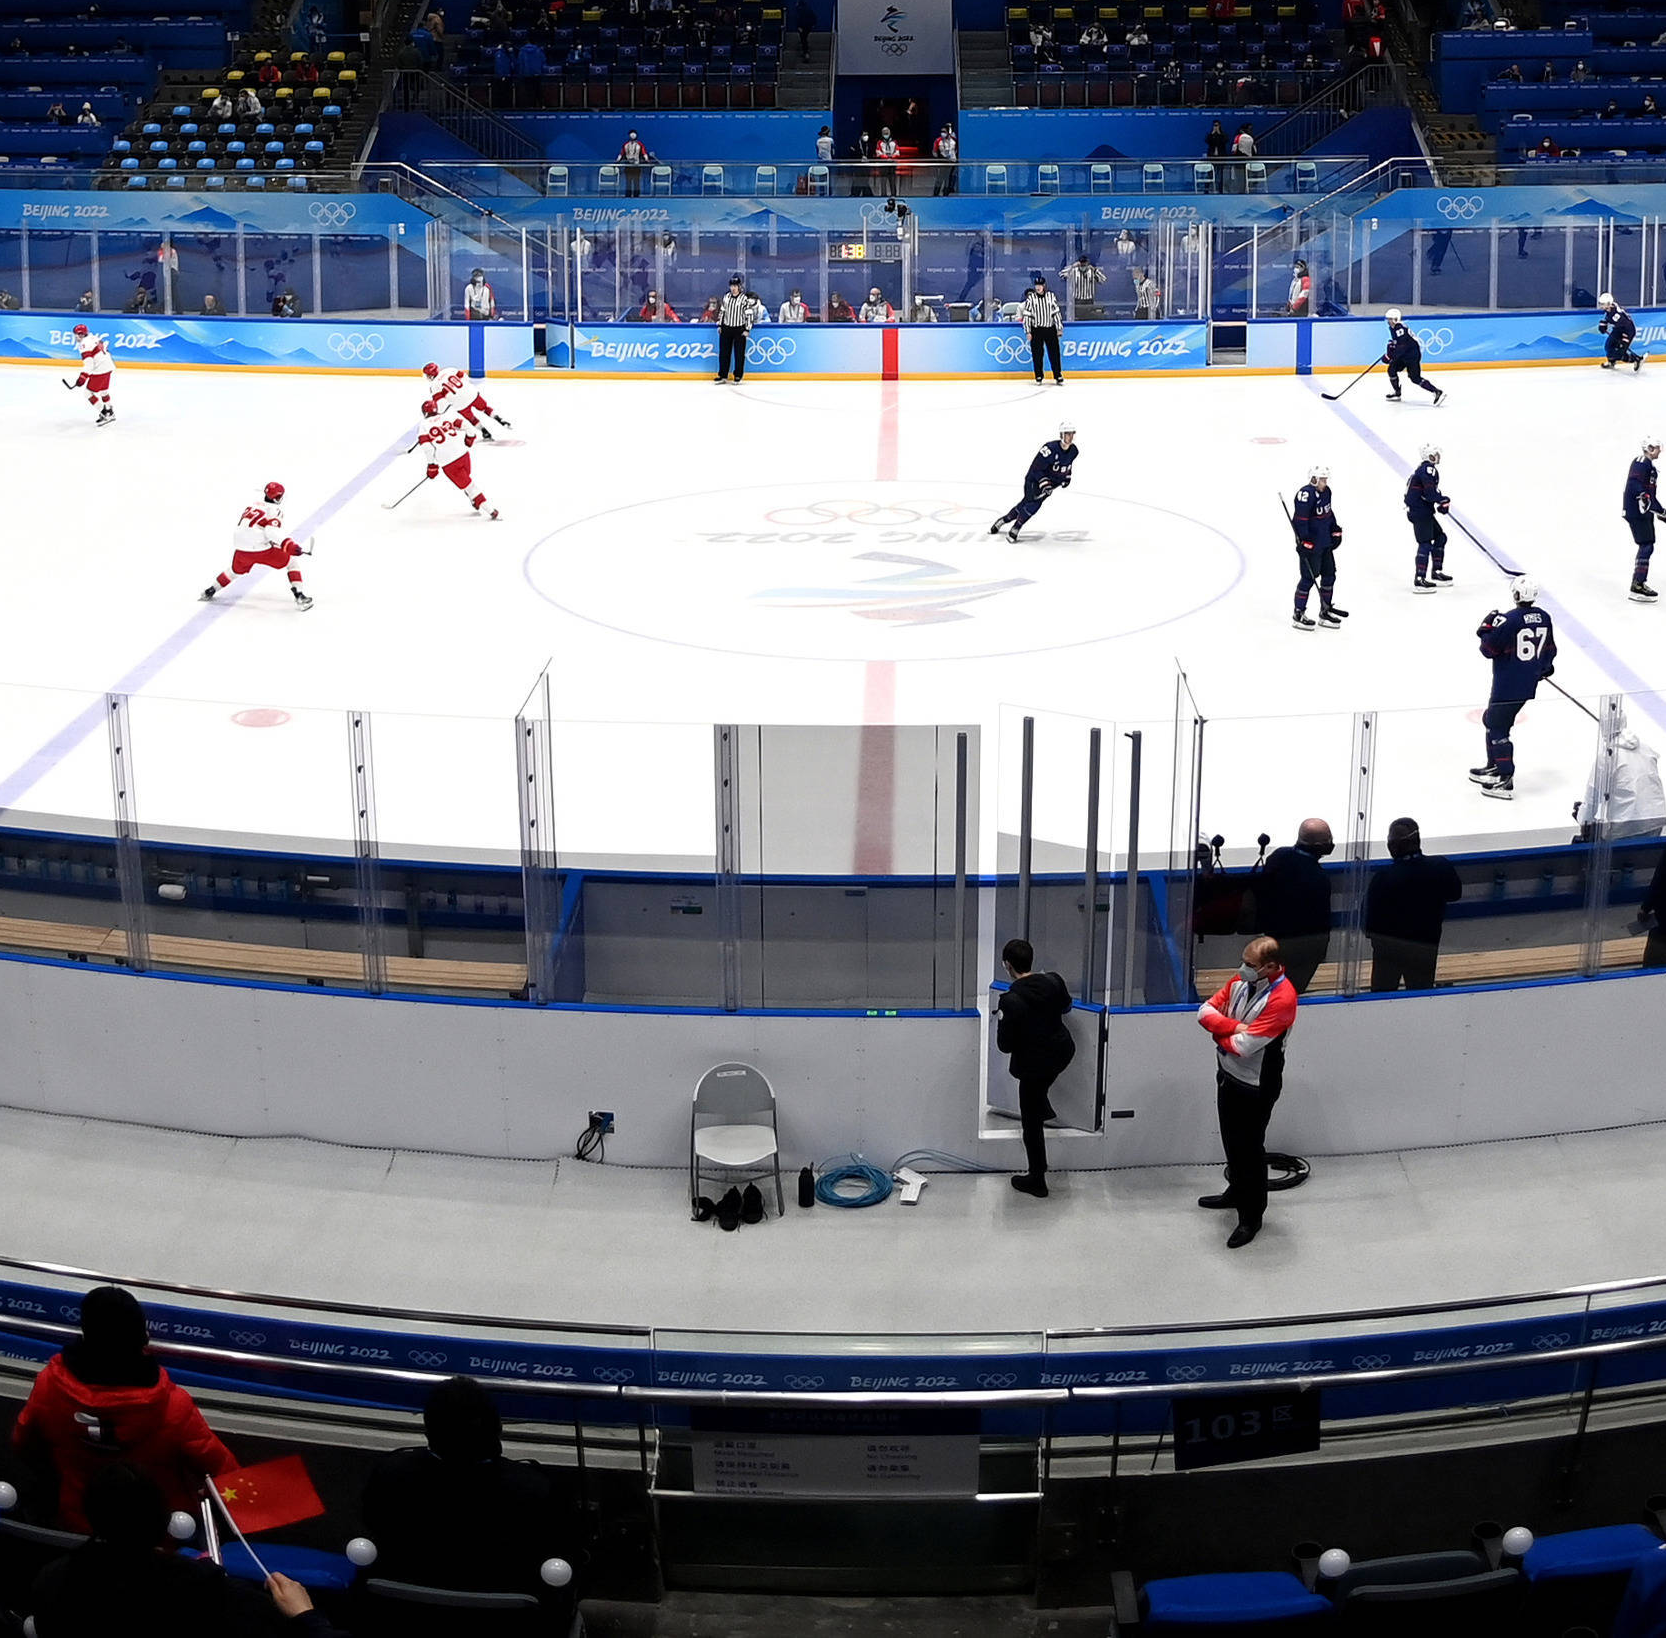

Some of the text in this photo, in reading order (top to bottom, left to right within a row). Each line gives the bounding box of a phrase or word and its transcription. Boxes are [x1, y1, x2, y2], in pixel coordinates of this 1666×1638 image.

[22, 203, 110, 219] BEIJING 2022
[572, 207, 671, 223] BEIJING 2022
[1100, 206, 1200, 221] BEIJING 2022
[114, 333, 162, 349] 2022
[1062, 339, 1191, 359] BEIJING 2022
[591, 342, 718, 360] BEIJING 2022
[441, 375, 464, 395] 10
[428, 420, 457, 444] 93
[697, 531, 857, 544] 2022
[1515, 625, 1549, 662] 67
[7, 1297, 48, 1314] 2022
[173, 1322, 216, 1339] 2022
[1590, 1323, 1644, 1341] BEIJING
[288, 1338, 393, 1360] BEIJING 2022
[1412, 1341, 1514, 1363] BEIJING 2022
[468, 1356, 577, 1378] BEIJING 2022
[1228, 1359, 1336, 1377] BEIJING 2022
[656, 1370, 769, 1387] BEIJING 2022
[849, 1375, 960, 1391] BEIJING 2022
[1039, 1370, 1150, 1388] BEIJING 2022
[1183, 1408, 1263, 1446] 103
